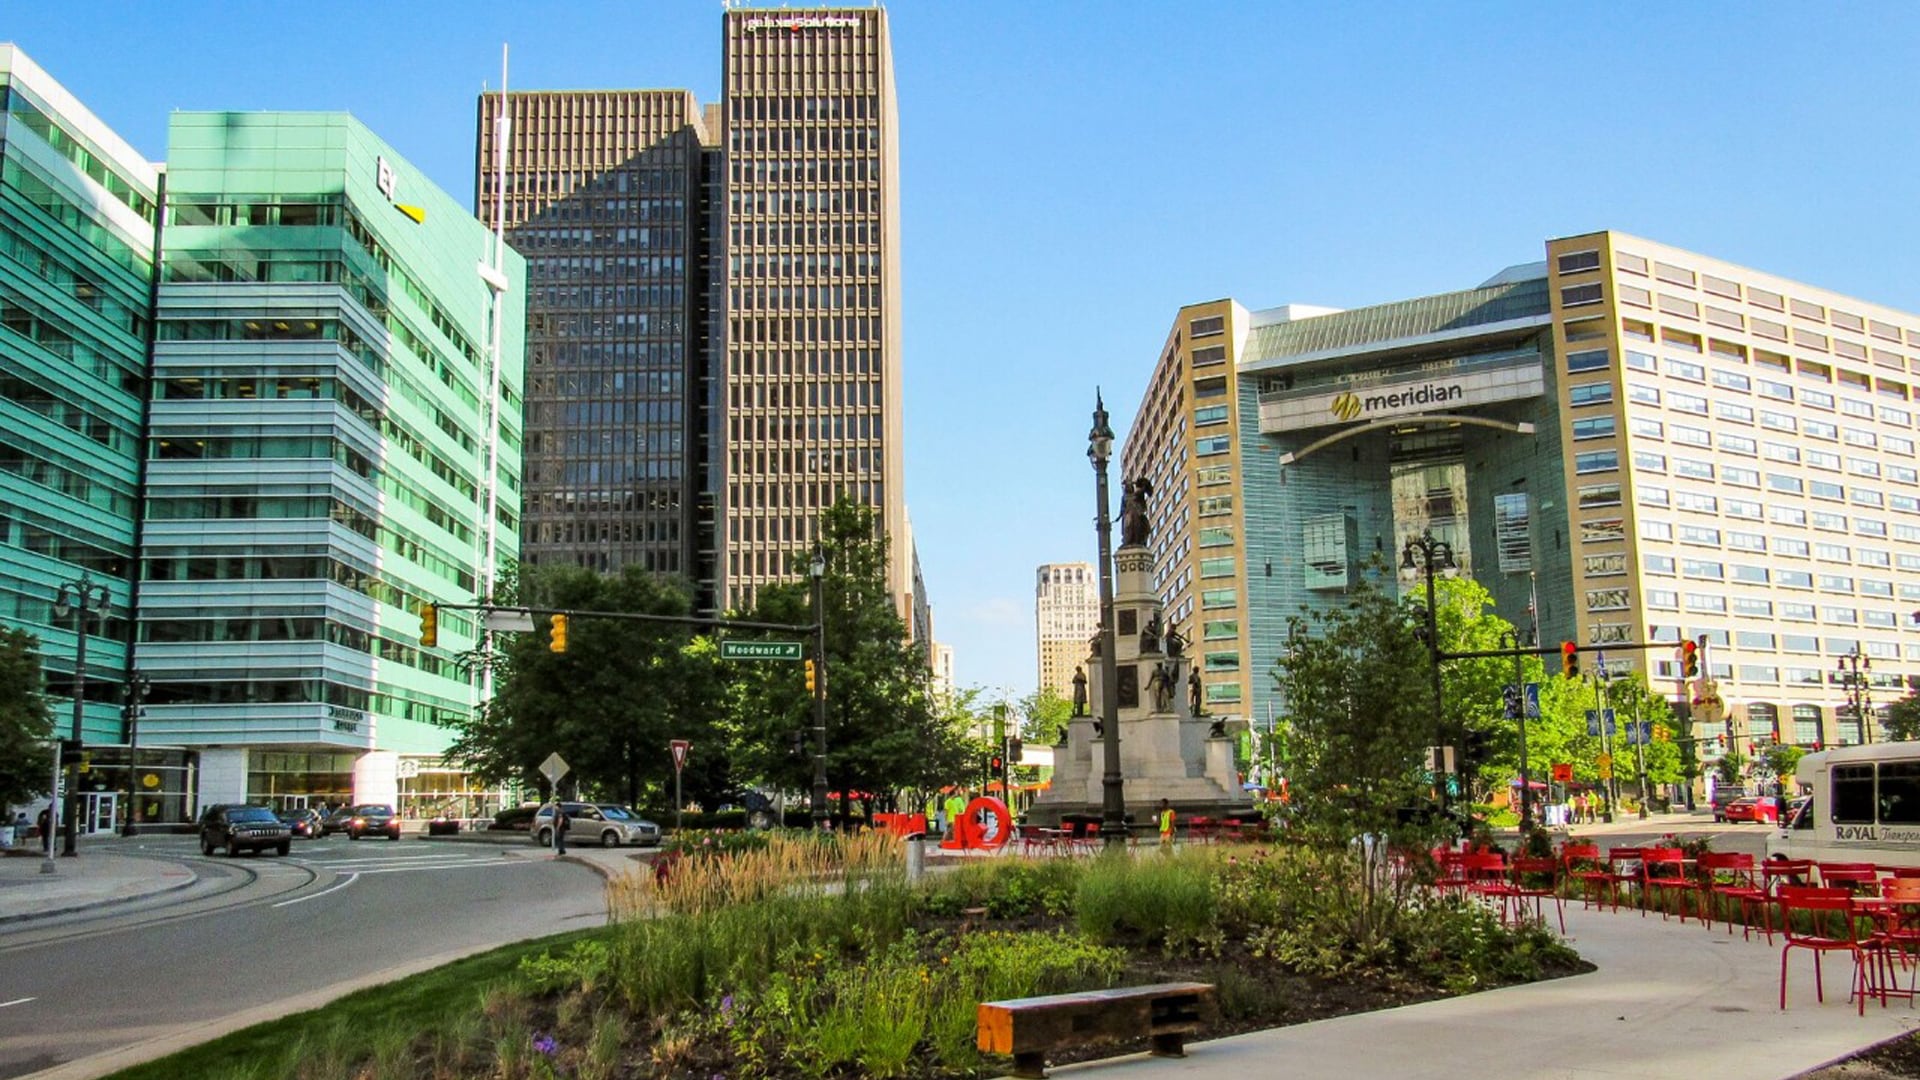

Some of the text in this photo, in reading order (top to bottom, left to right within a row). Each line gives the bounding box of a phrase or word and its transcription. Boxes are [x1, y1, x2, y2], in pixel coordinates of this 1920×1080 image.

[377, 155, 397, 202] EY
[1365, 384, 1462, 411] meridian
[727, 645, 781, 655] Woodward
[1836, 826, 1878, 841] ROYAL
